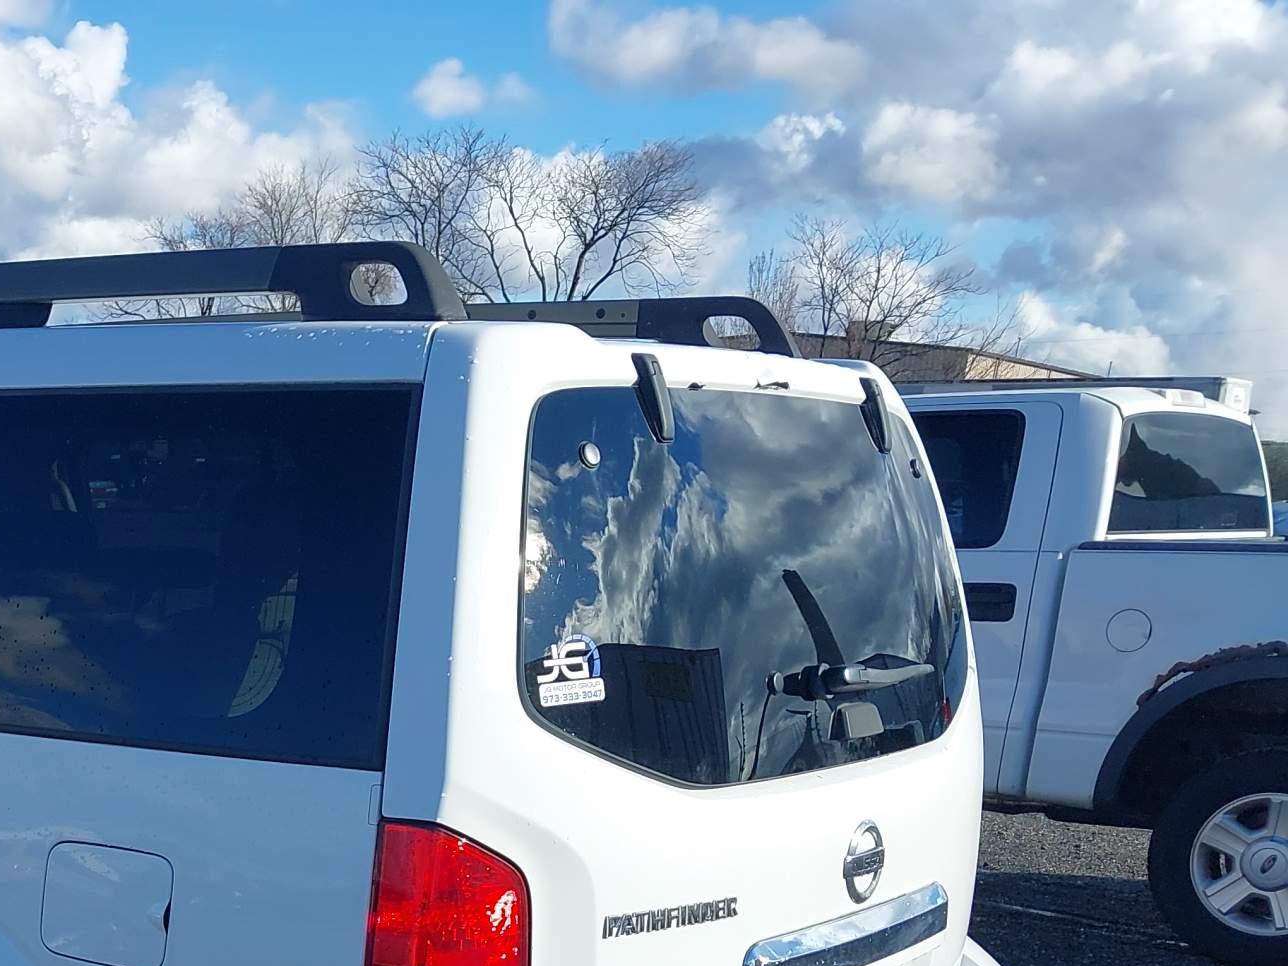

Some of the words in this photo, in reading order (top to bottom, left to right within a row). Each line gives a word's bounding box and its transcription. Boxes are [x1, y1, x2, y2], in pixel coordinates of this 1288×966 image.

[553, 684, 577, 692] MOTOR
[578, 680, 601, 689] GROUP
[542, 689, 602, 704] 973-333-3047
[602, 897, 738, 939] PATHFINDER
